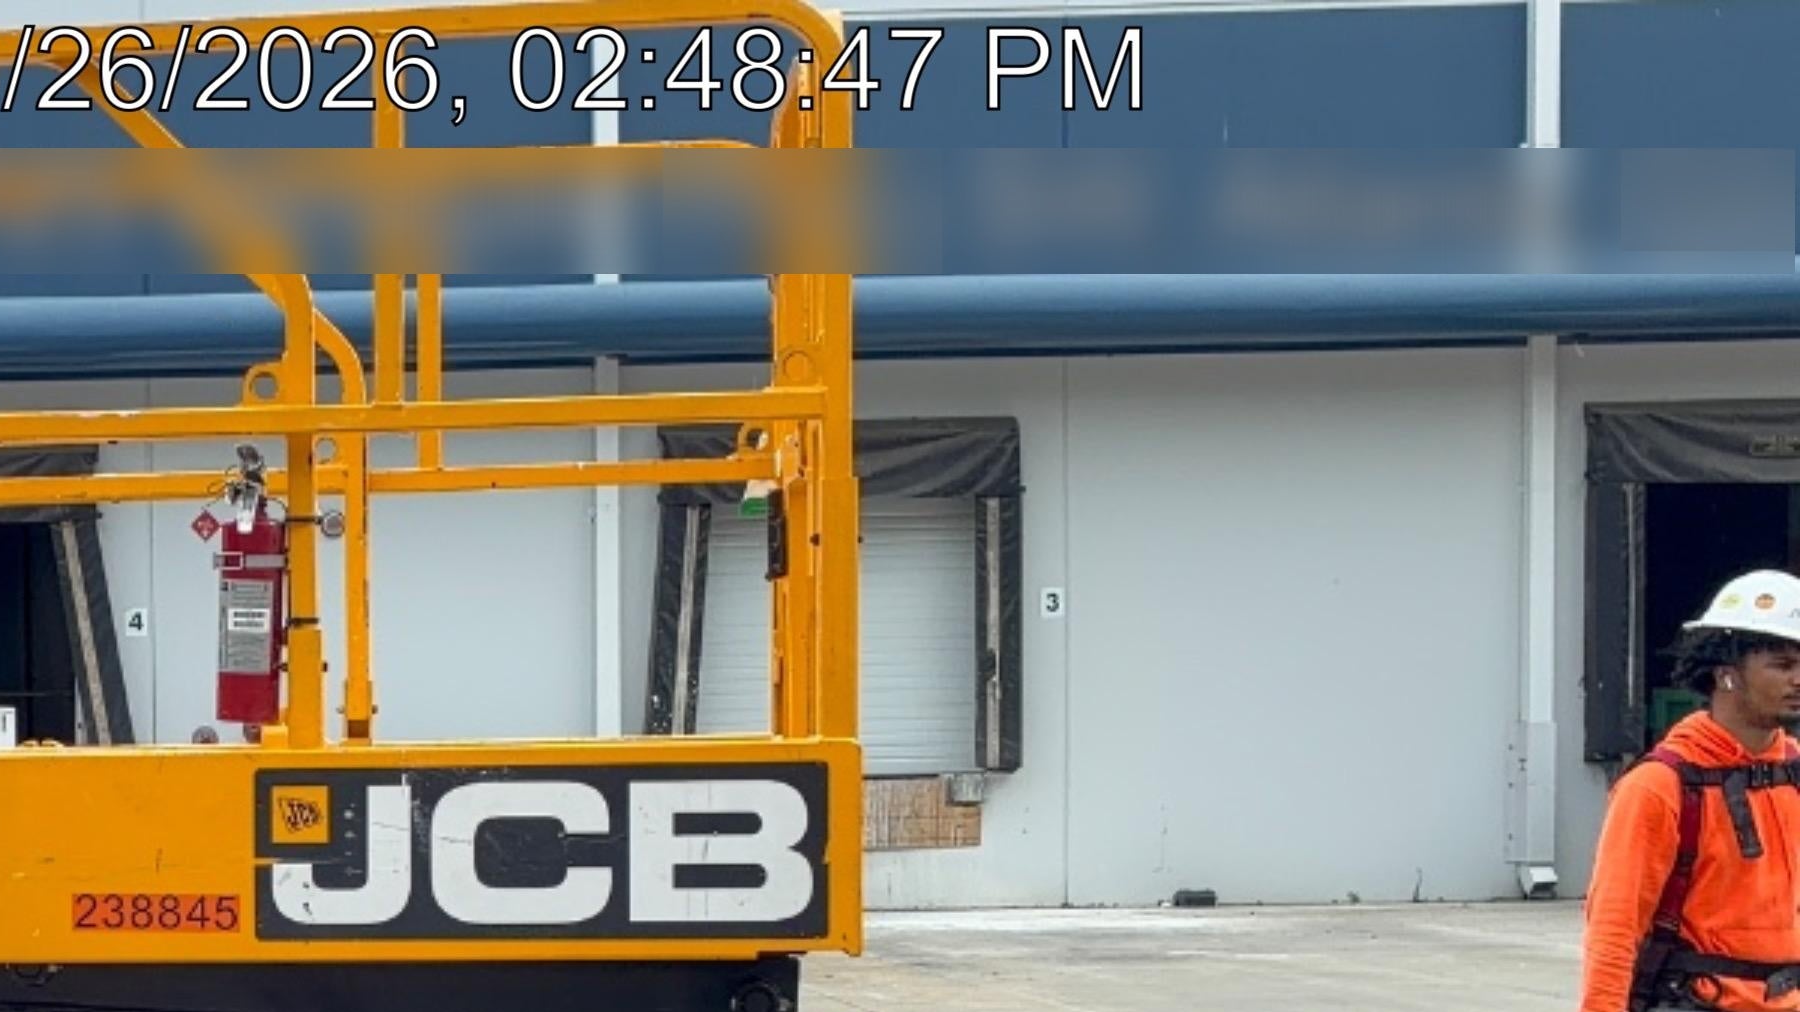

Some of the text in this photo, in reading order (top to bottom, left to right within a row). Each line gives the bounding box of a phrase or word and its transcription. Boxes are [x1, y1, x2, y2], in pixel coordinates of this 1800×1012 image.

[1046, 592, 1060, 612] 3
[128, 611, 144, 631] 4
[272, 779, 814, 925] JCB
[74, 893, 238, 931] 238845
